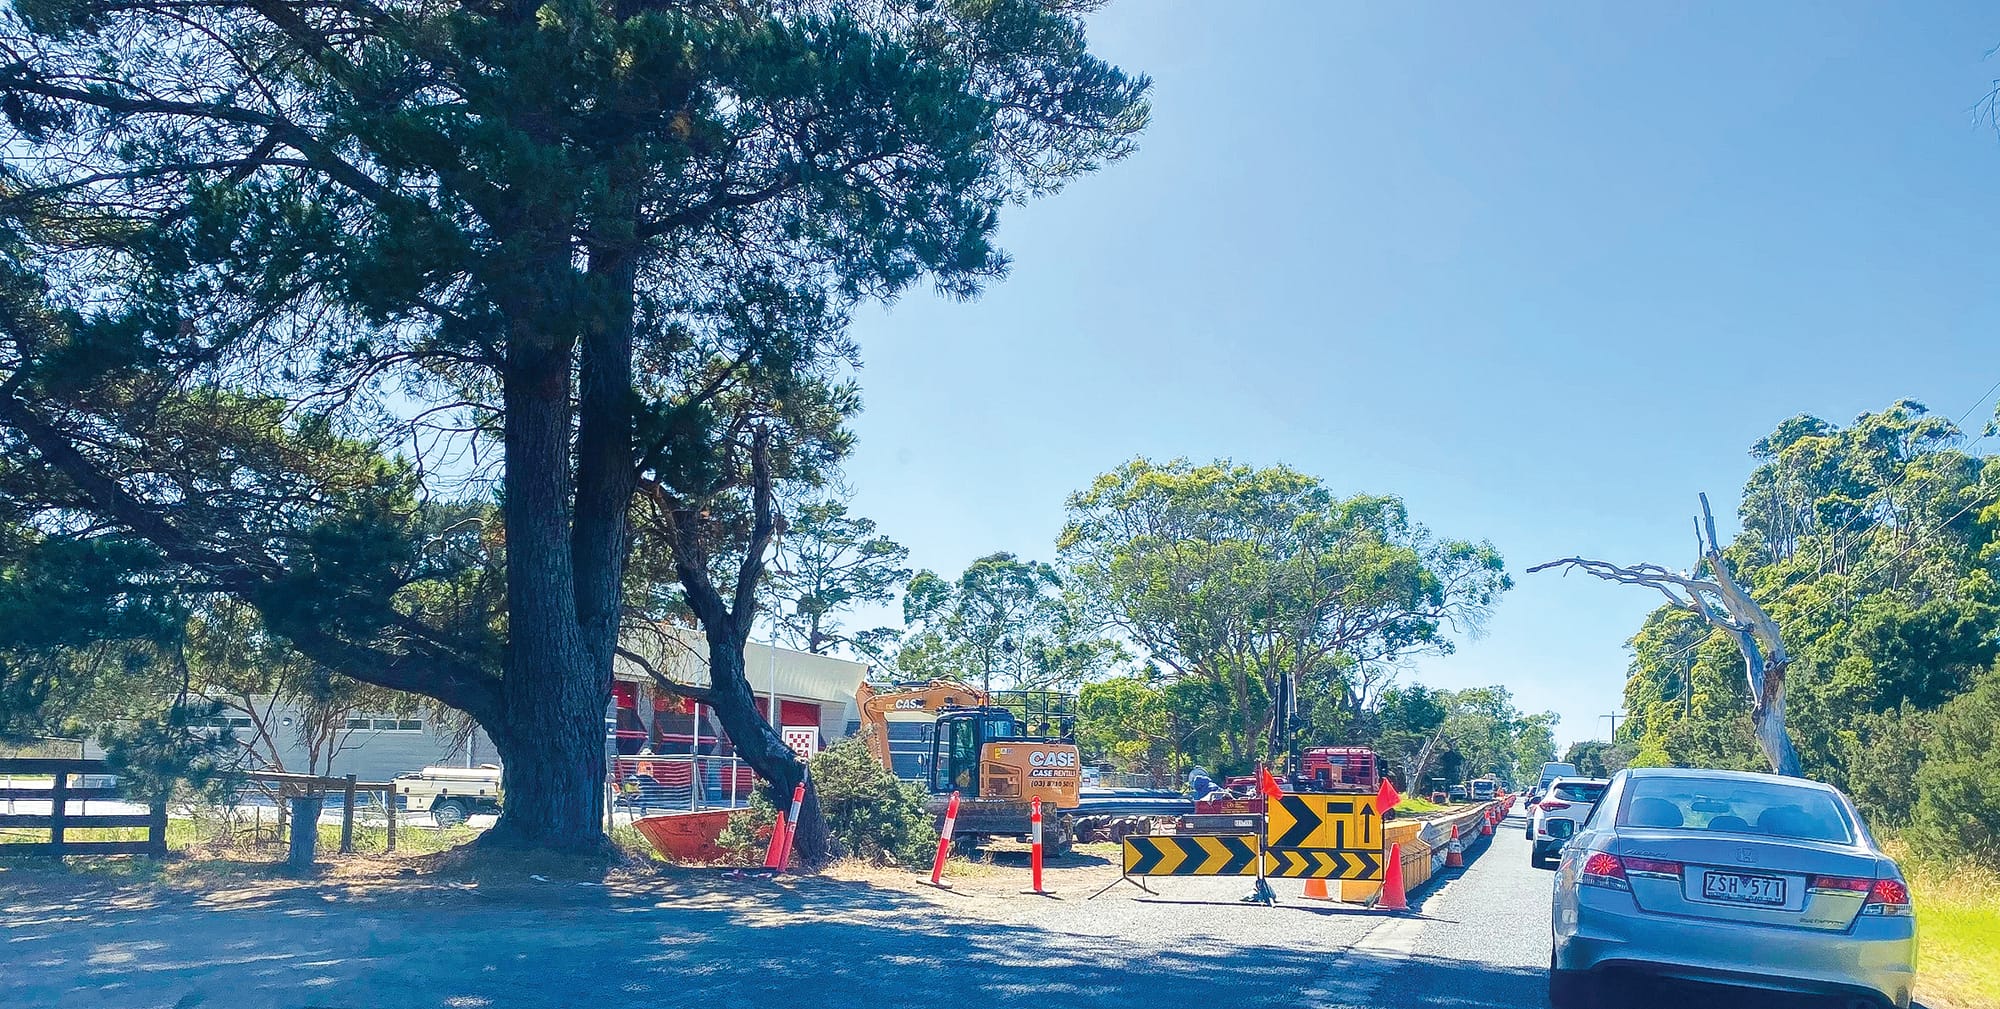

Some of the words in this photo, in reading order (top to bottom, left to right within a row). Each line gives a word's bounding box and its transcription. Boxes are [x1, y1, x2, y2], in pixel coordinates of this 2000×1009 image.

[1029, 751, 1075, 767] CASE
[1032, 769, 1053, 777] CASE
[1707, 875, 1739, 893] ZSH
[1751, 879, 1780, 898] 571
